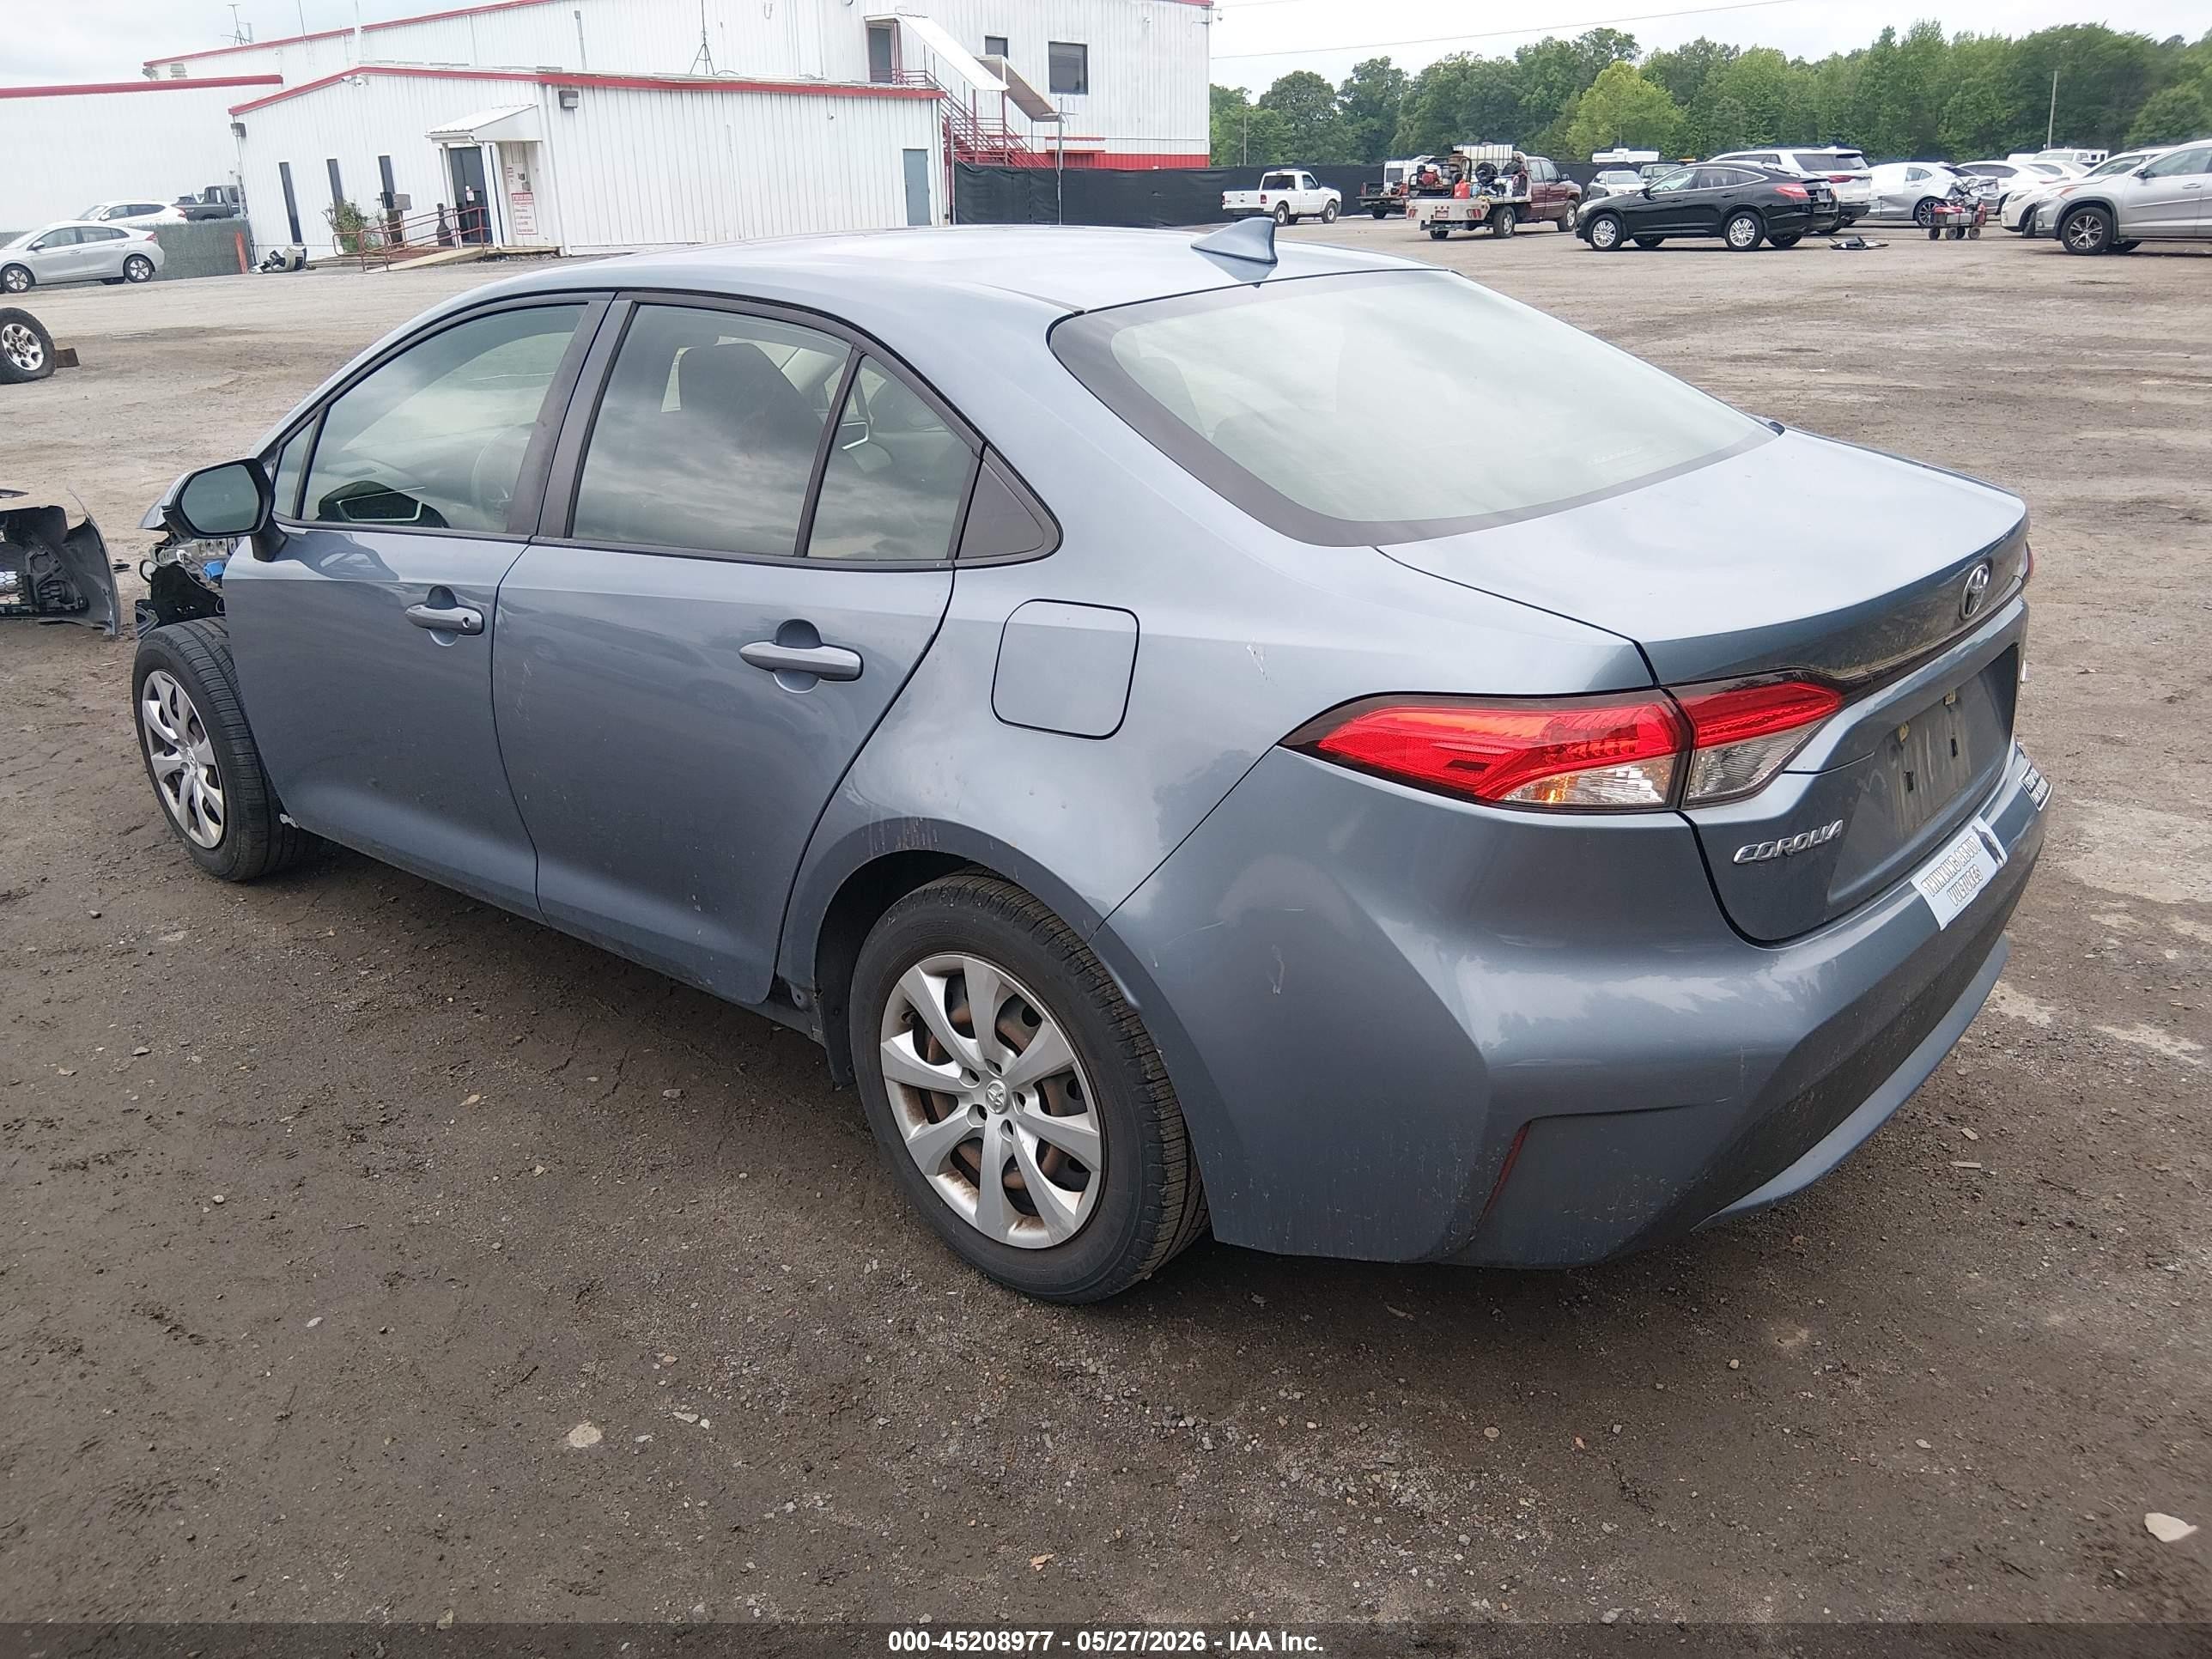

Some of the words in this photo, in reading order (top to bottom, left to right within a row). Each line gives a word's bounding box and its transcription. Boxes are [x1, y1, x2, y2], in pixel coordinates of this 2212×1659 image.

[1733, 819, 1844, 864] COROLLA
[1920, 854, 1961, 897] THINKING
[1955, 836, 1981, 866] ABOUT
[1946, 864, 1984, 907] VULTURES
